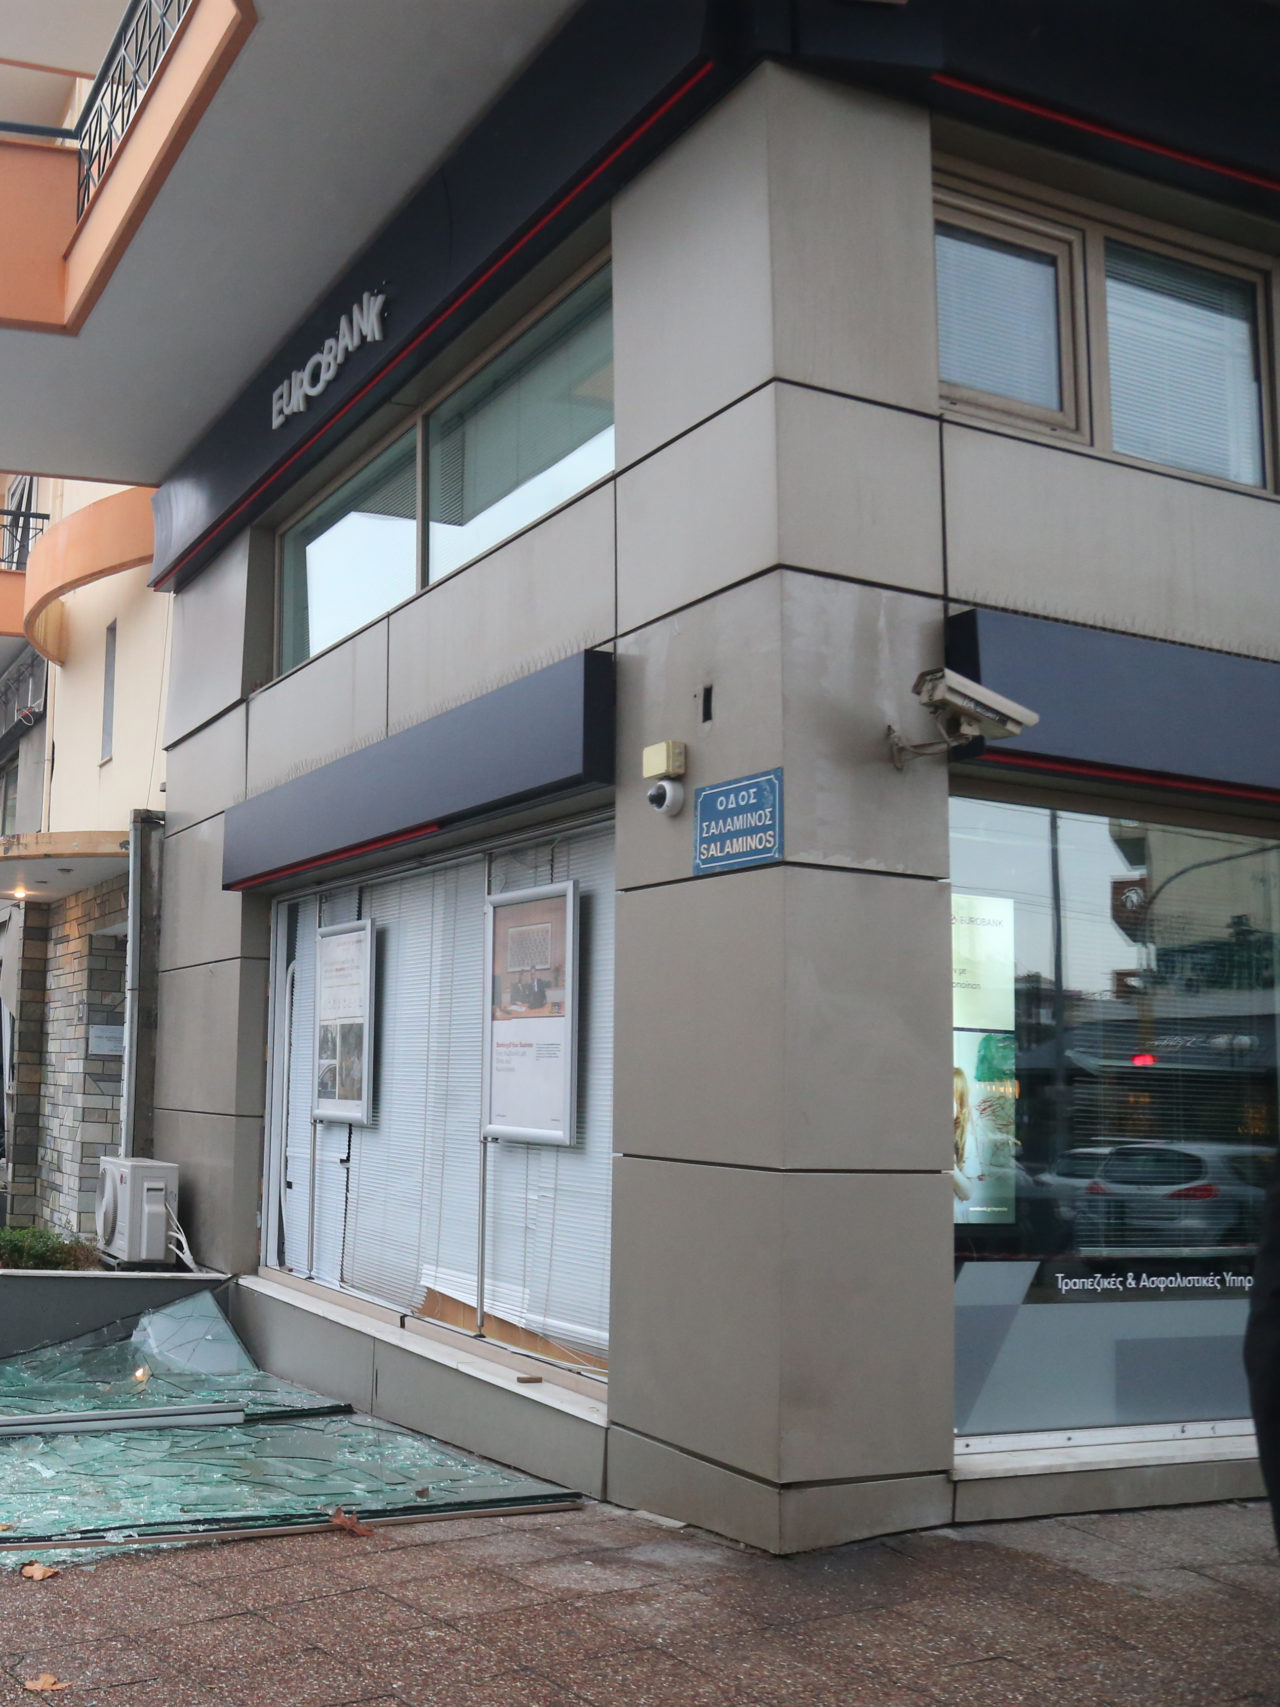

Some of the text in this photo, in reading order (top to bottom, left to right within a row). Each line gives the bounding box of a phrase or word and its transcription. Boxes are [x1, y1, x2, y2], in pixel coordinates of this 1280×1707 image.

[272, 291, 386, 430] EUROBANK
[717, 788, 757, 810] ΟΔΟΣ
[702, 808, 773, 838] ΣΑΛΑΜΙΝΟΣ
[700, 830, 775, 860] SALAMINOS
[959, 916, 1005, 928] EUROBANK
[1055, 1273, 1123, 1294] Τραπεζικές
[1126, 1272, 1136, 1288] &
[1139, 1272, 1221, 1291] Ασφαλιστικές
